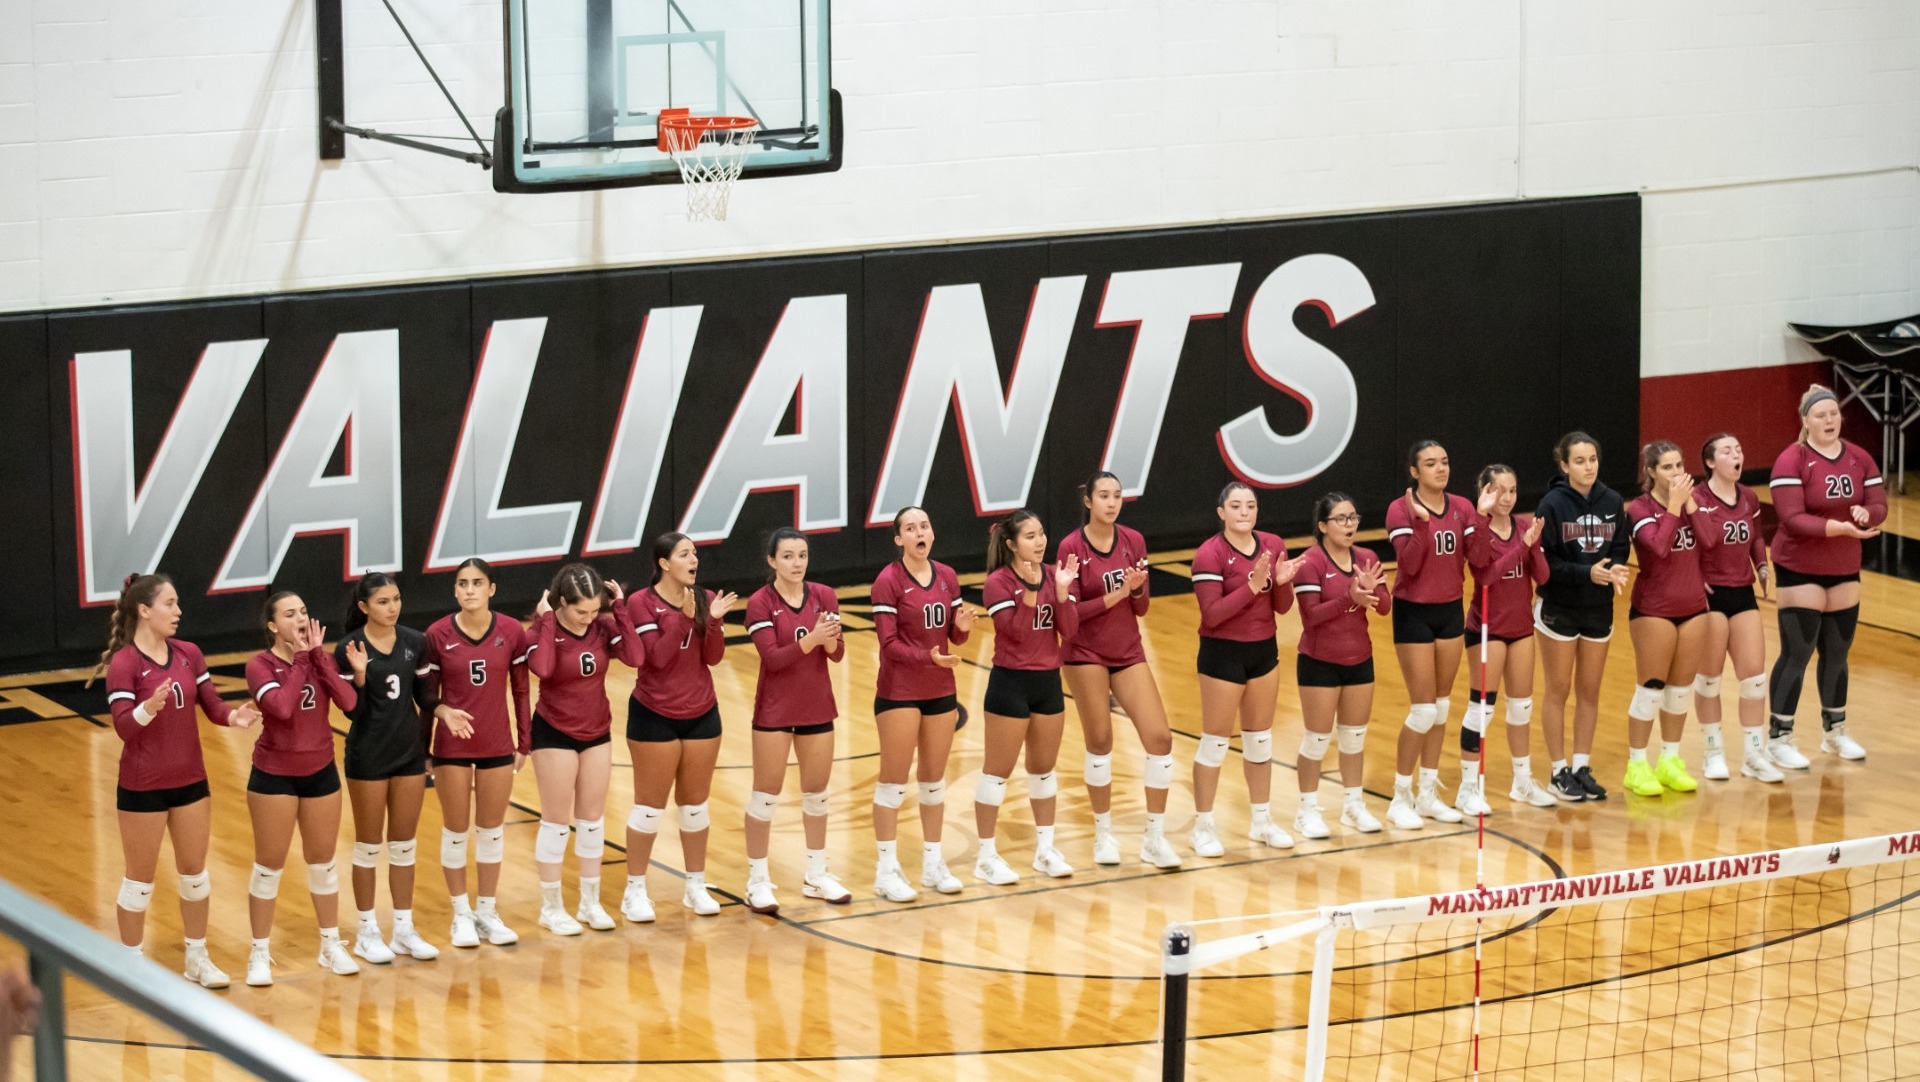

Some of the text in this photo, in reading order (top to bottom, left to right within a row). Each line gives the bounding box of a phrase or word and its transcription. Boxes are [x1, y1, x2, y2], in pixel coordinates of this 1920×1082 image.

[69, 252, 1378, 608] VALIANTS
[1825, 474, 1854, 499] 28
[1434, 530, 1456, 556] 18
[1670, 525, 1697, 552] 25
[1723, 520, 1750, 545] 26
[1102, 568, 1126, 595] 15
[923, 602, 946, 629] 10
[1032, 603, 1054, 631] 12
[469, 659, 487, 686] 5
[580, 651, 596, 677] 6
[171, 681, 184, 709] 1
[300, 683, 316, 711] 2
[386, 674, 401, 700] 3
[1427, 852, 1781, 917] MANHATTANVILLE VALIANTS
